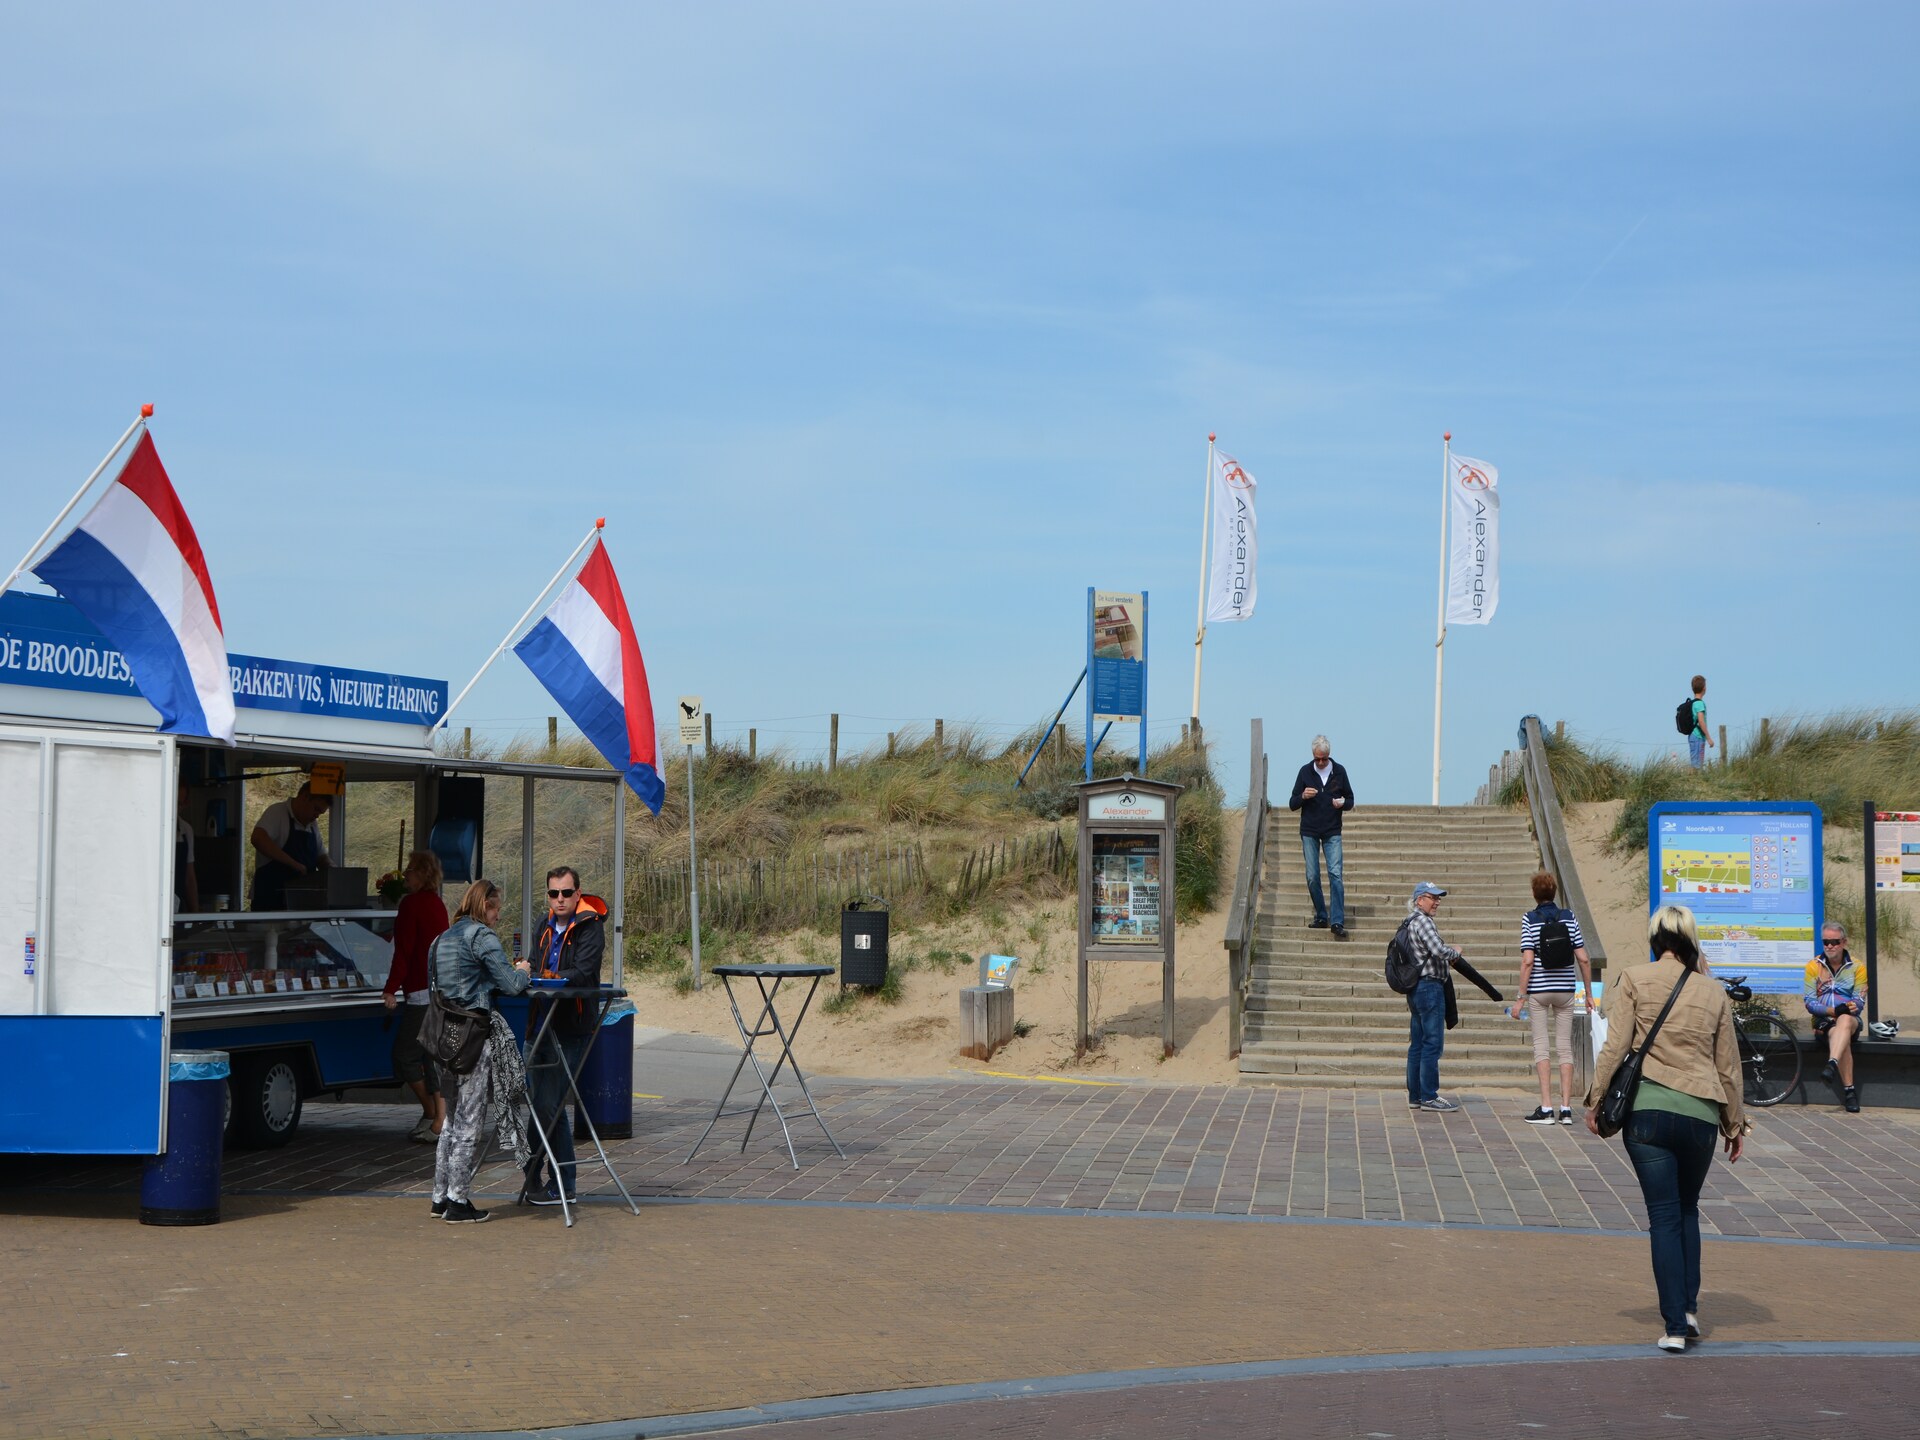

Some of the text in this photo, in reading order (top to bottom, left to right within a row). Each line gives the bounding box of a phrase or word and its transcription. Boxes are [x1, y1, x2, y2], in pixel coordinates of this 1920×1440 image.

[1232, 496, 1247, 616] Alexander
[1472, 498, 1486, 618] Alexander
[26, 641, 135, 687] BROODJES,
[297, 674, 325, 707] VIS,
[329, 677, 384, 709] NIEUWE
[387, 685, 438, 715] HARING
[1103, 807, 1152, 815] Alexander
